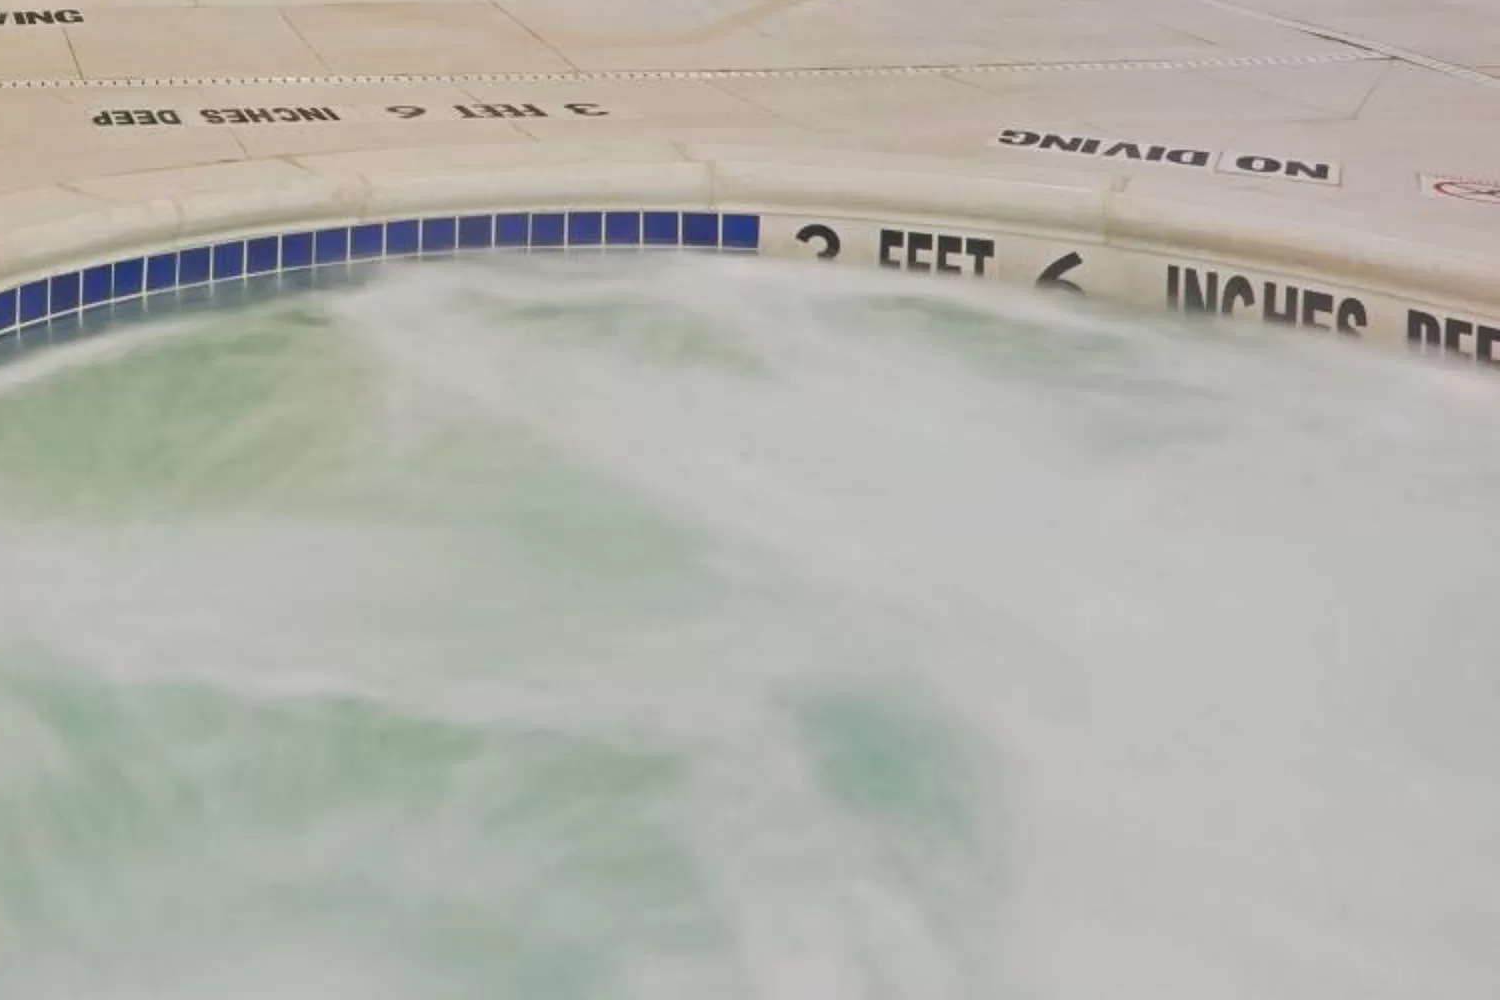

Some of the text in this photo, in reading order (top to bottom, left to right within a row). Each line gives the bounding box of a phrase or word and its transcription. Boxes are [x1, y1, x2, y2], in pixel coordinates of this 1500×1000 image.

[92, 109, 182, 126] DEEP
[200, 107, 341, 124] INCHES
[452, 103, 549, 119] FEET
[563, 103, 610, 117] 3
[998, 129, 1329, 180] NO DIVING
